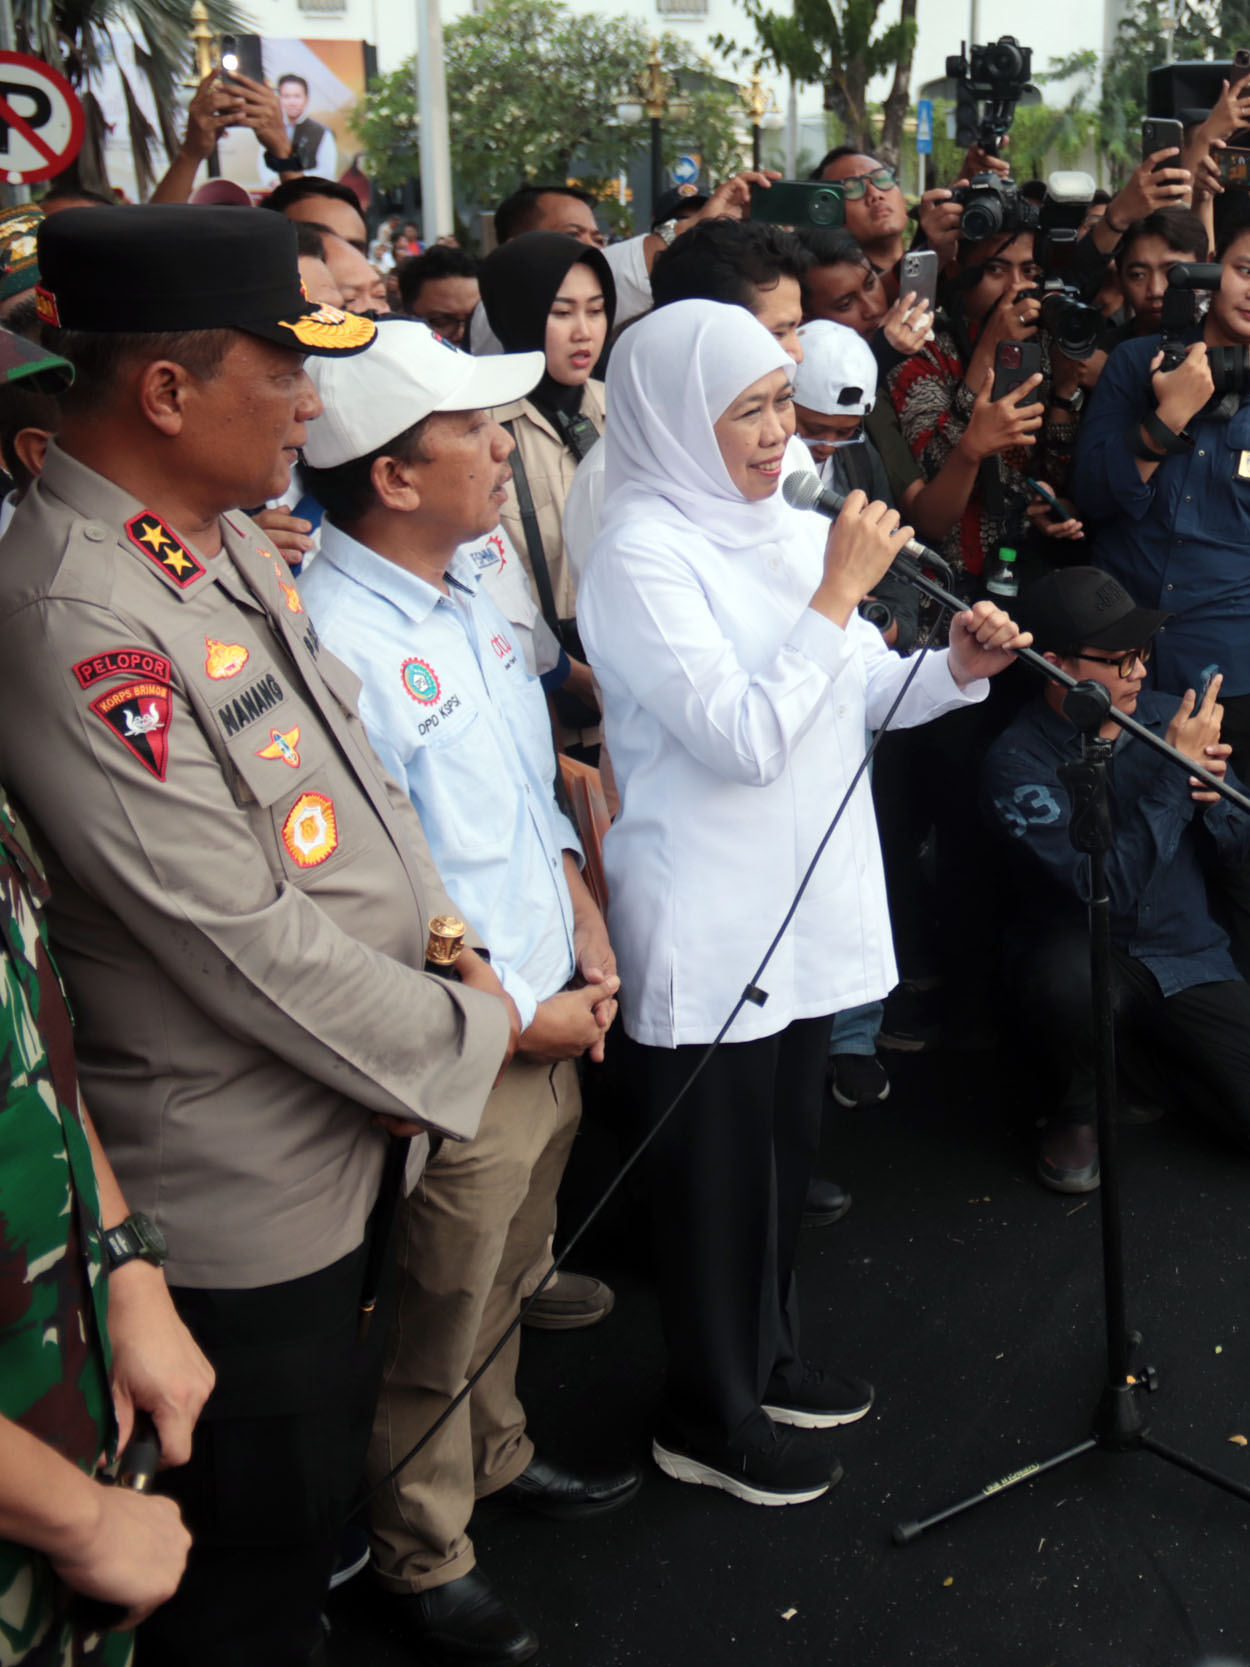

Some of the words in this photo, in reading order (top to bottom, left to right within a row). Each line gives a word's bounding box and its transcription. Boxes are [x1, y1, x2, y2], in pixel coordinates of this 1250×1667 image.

[80, 654, 165, 681] PELOPOR
[99, 686, 133, 713] KORPS
[133, 683, 168, 699] BRIMOB
[417, 713, 441, 736] DPD
[438, 694, 462, 720] KSPSI
